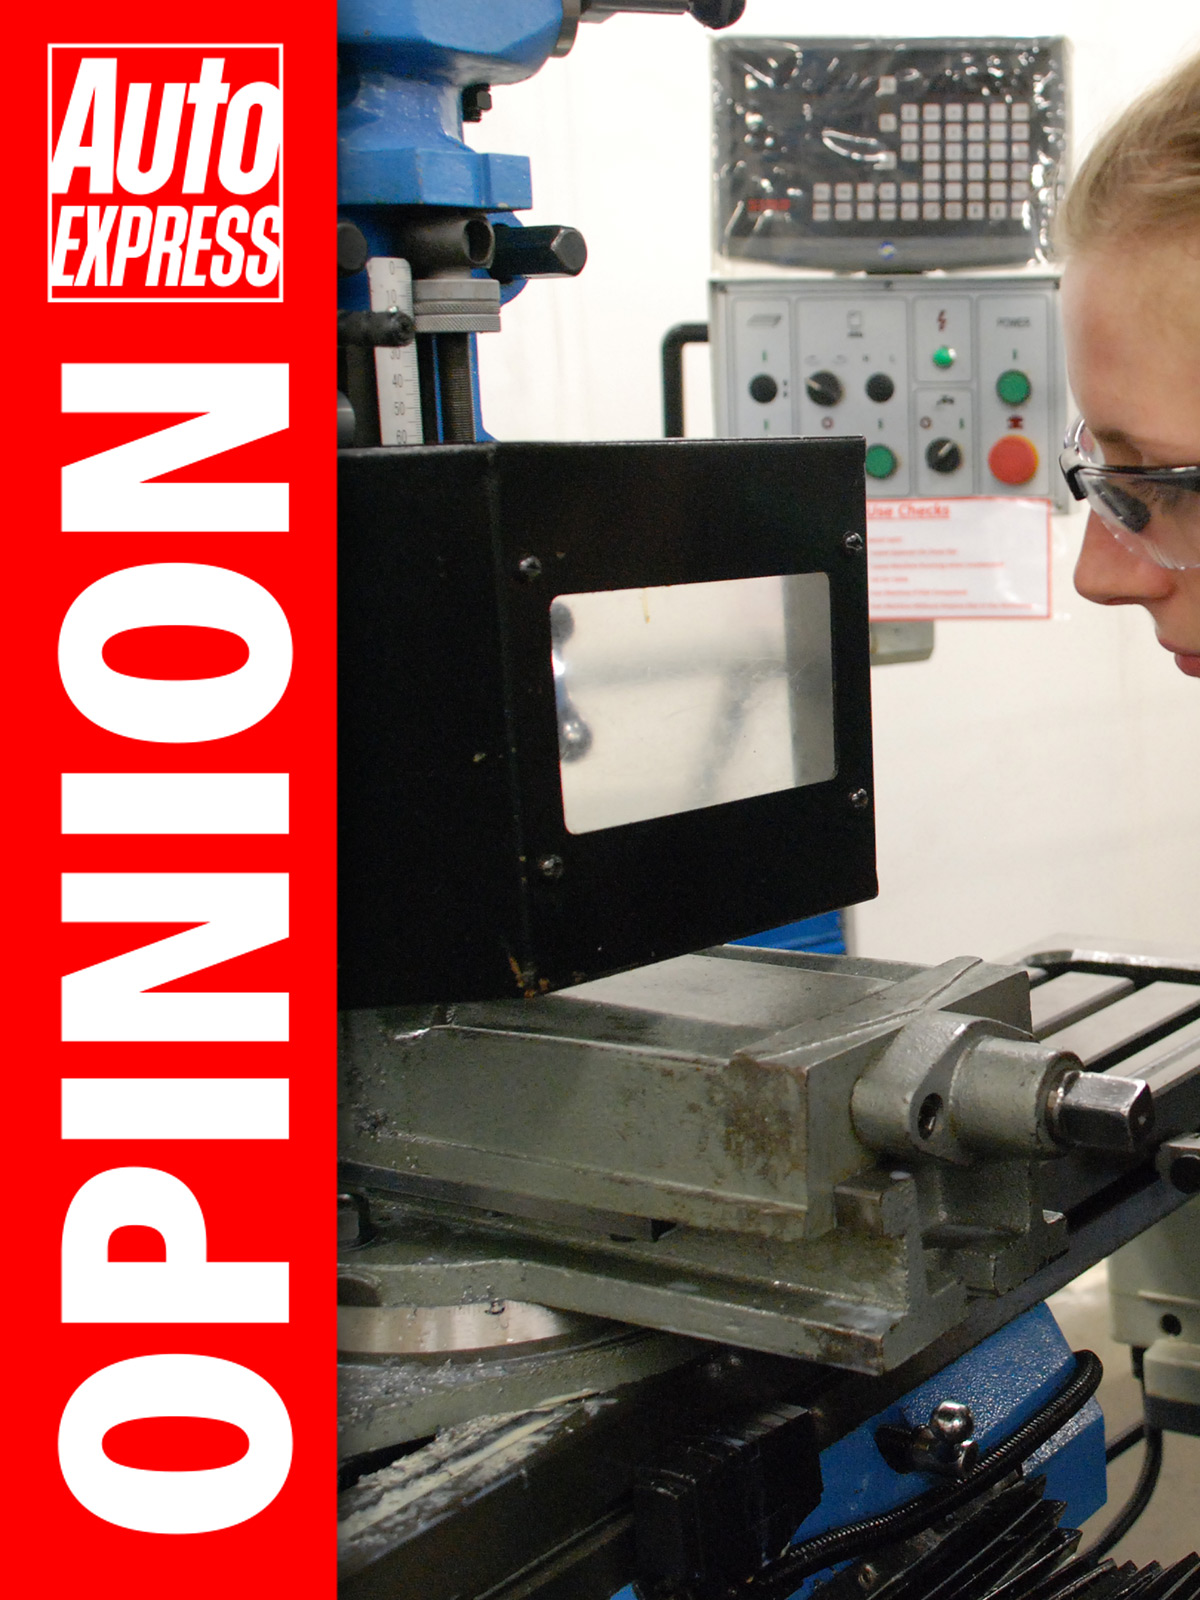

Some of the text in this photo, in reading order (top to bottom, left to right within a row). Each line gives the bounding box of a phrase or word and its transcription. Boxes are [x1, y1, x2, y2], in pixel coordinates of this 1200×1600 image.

[392, 373, 403, 388] 40
[394, 401, 405, 415] 50
[898, 501, 949, 517] Checks
